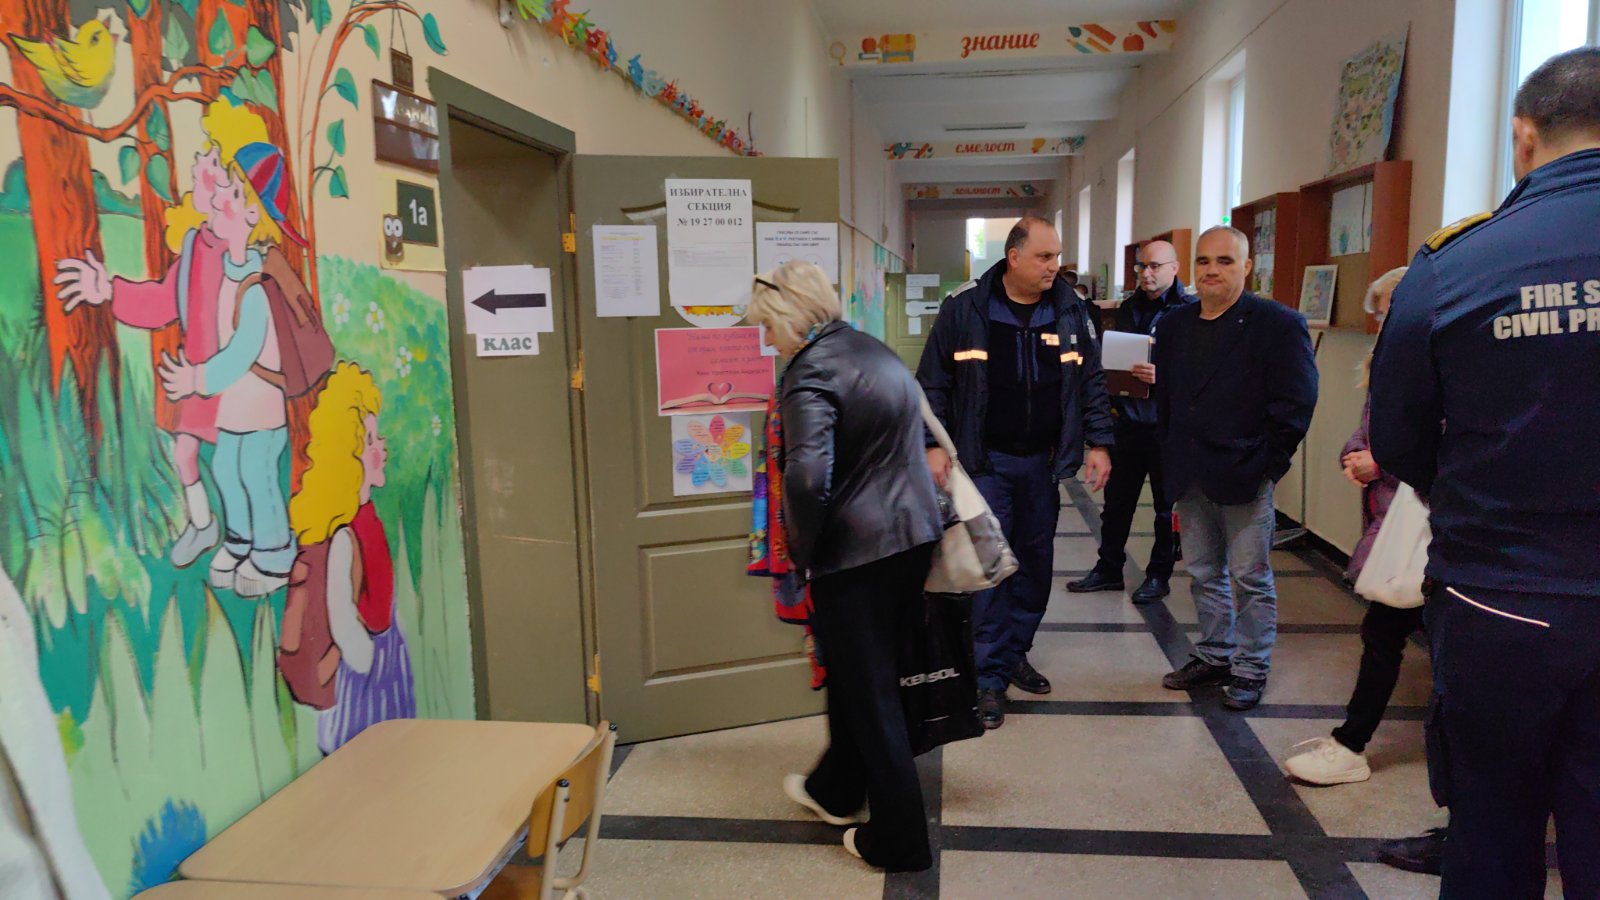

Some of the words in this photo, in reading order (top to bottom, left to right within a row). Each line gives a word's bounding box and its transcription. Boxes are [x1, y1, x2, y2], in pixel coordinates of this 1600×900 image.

[960, 33, 1040, 59] знание
[955, 142, 1016, 154] смелост
[669, 188, 748, 197] ИЗБИРАТЕЛНА
[687, 202, 732, 212] СЕКЦИЯ
[677, 217, 688, 227] №
[691, 217, 701, 226] 19
[703, 217, 713, 226] 27
[715, 217, 726, 226] 00
[727, 217, 743, 226] 012
[1521, 281, 1578, 310] FIRE
[1493, 310, 1564, 340] CIVIL
[483, 337, 532, 352] клас
